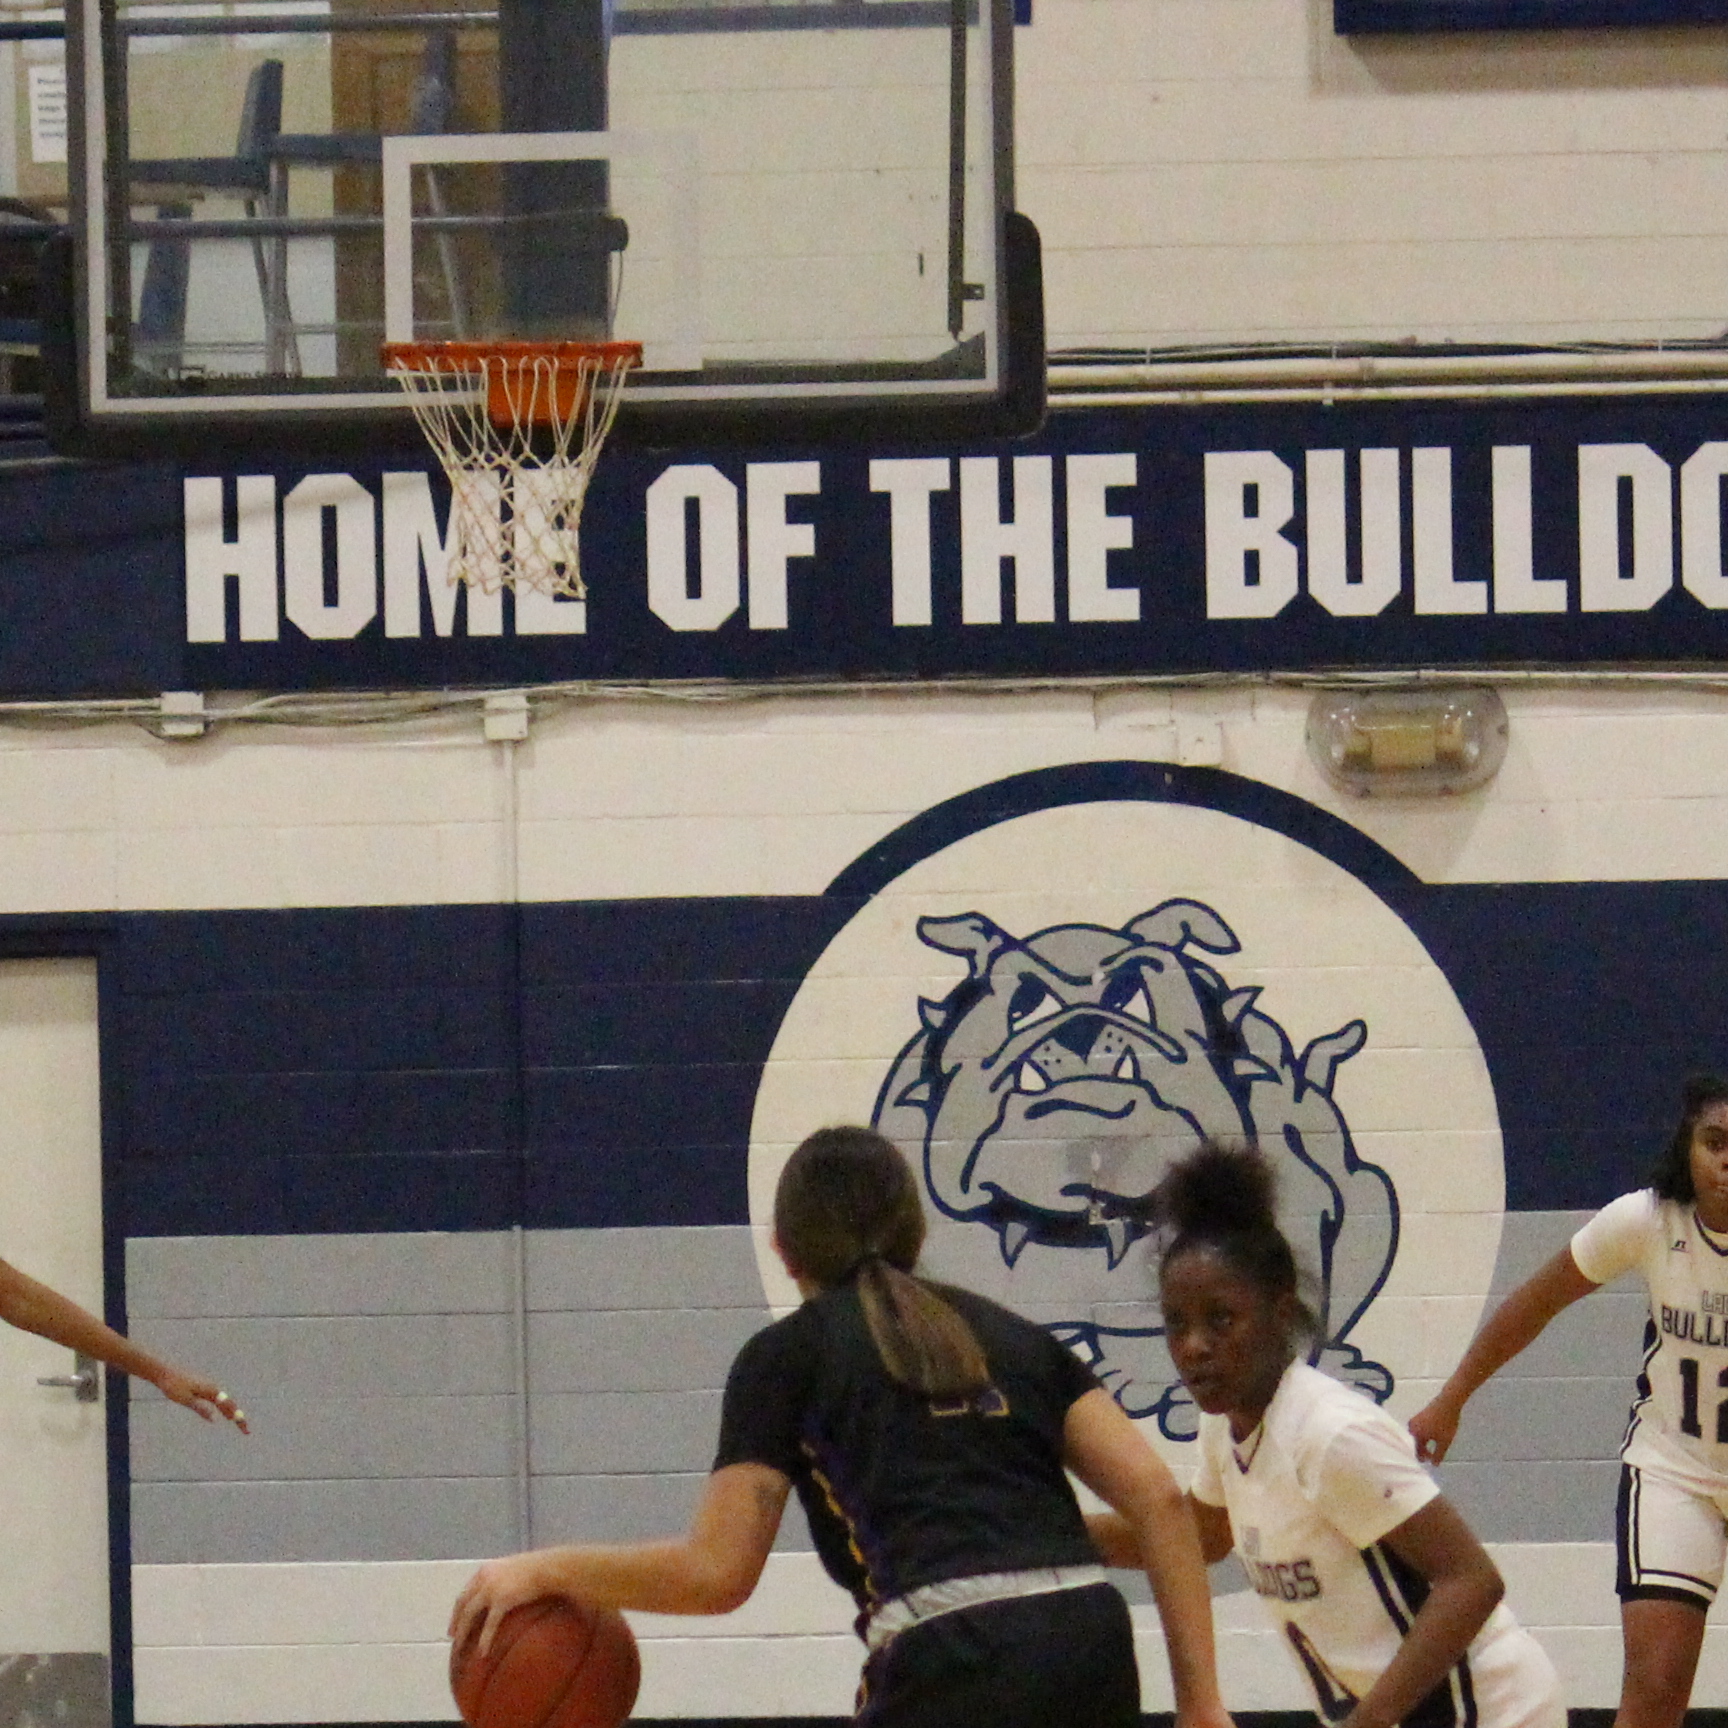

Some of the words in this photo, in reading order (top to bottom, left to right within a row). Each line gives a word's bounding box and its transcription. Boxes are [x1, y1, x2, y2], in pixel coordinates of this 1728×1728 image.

[184, 470, 586, 643] HOME
[646, 462, 821, 632] OF
[869, 453, 1141, 627] THE
